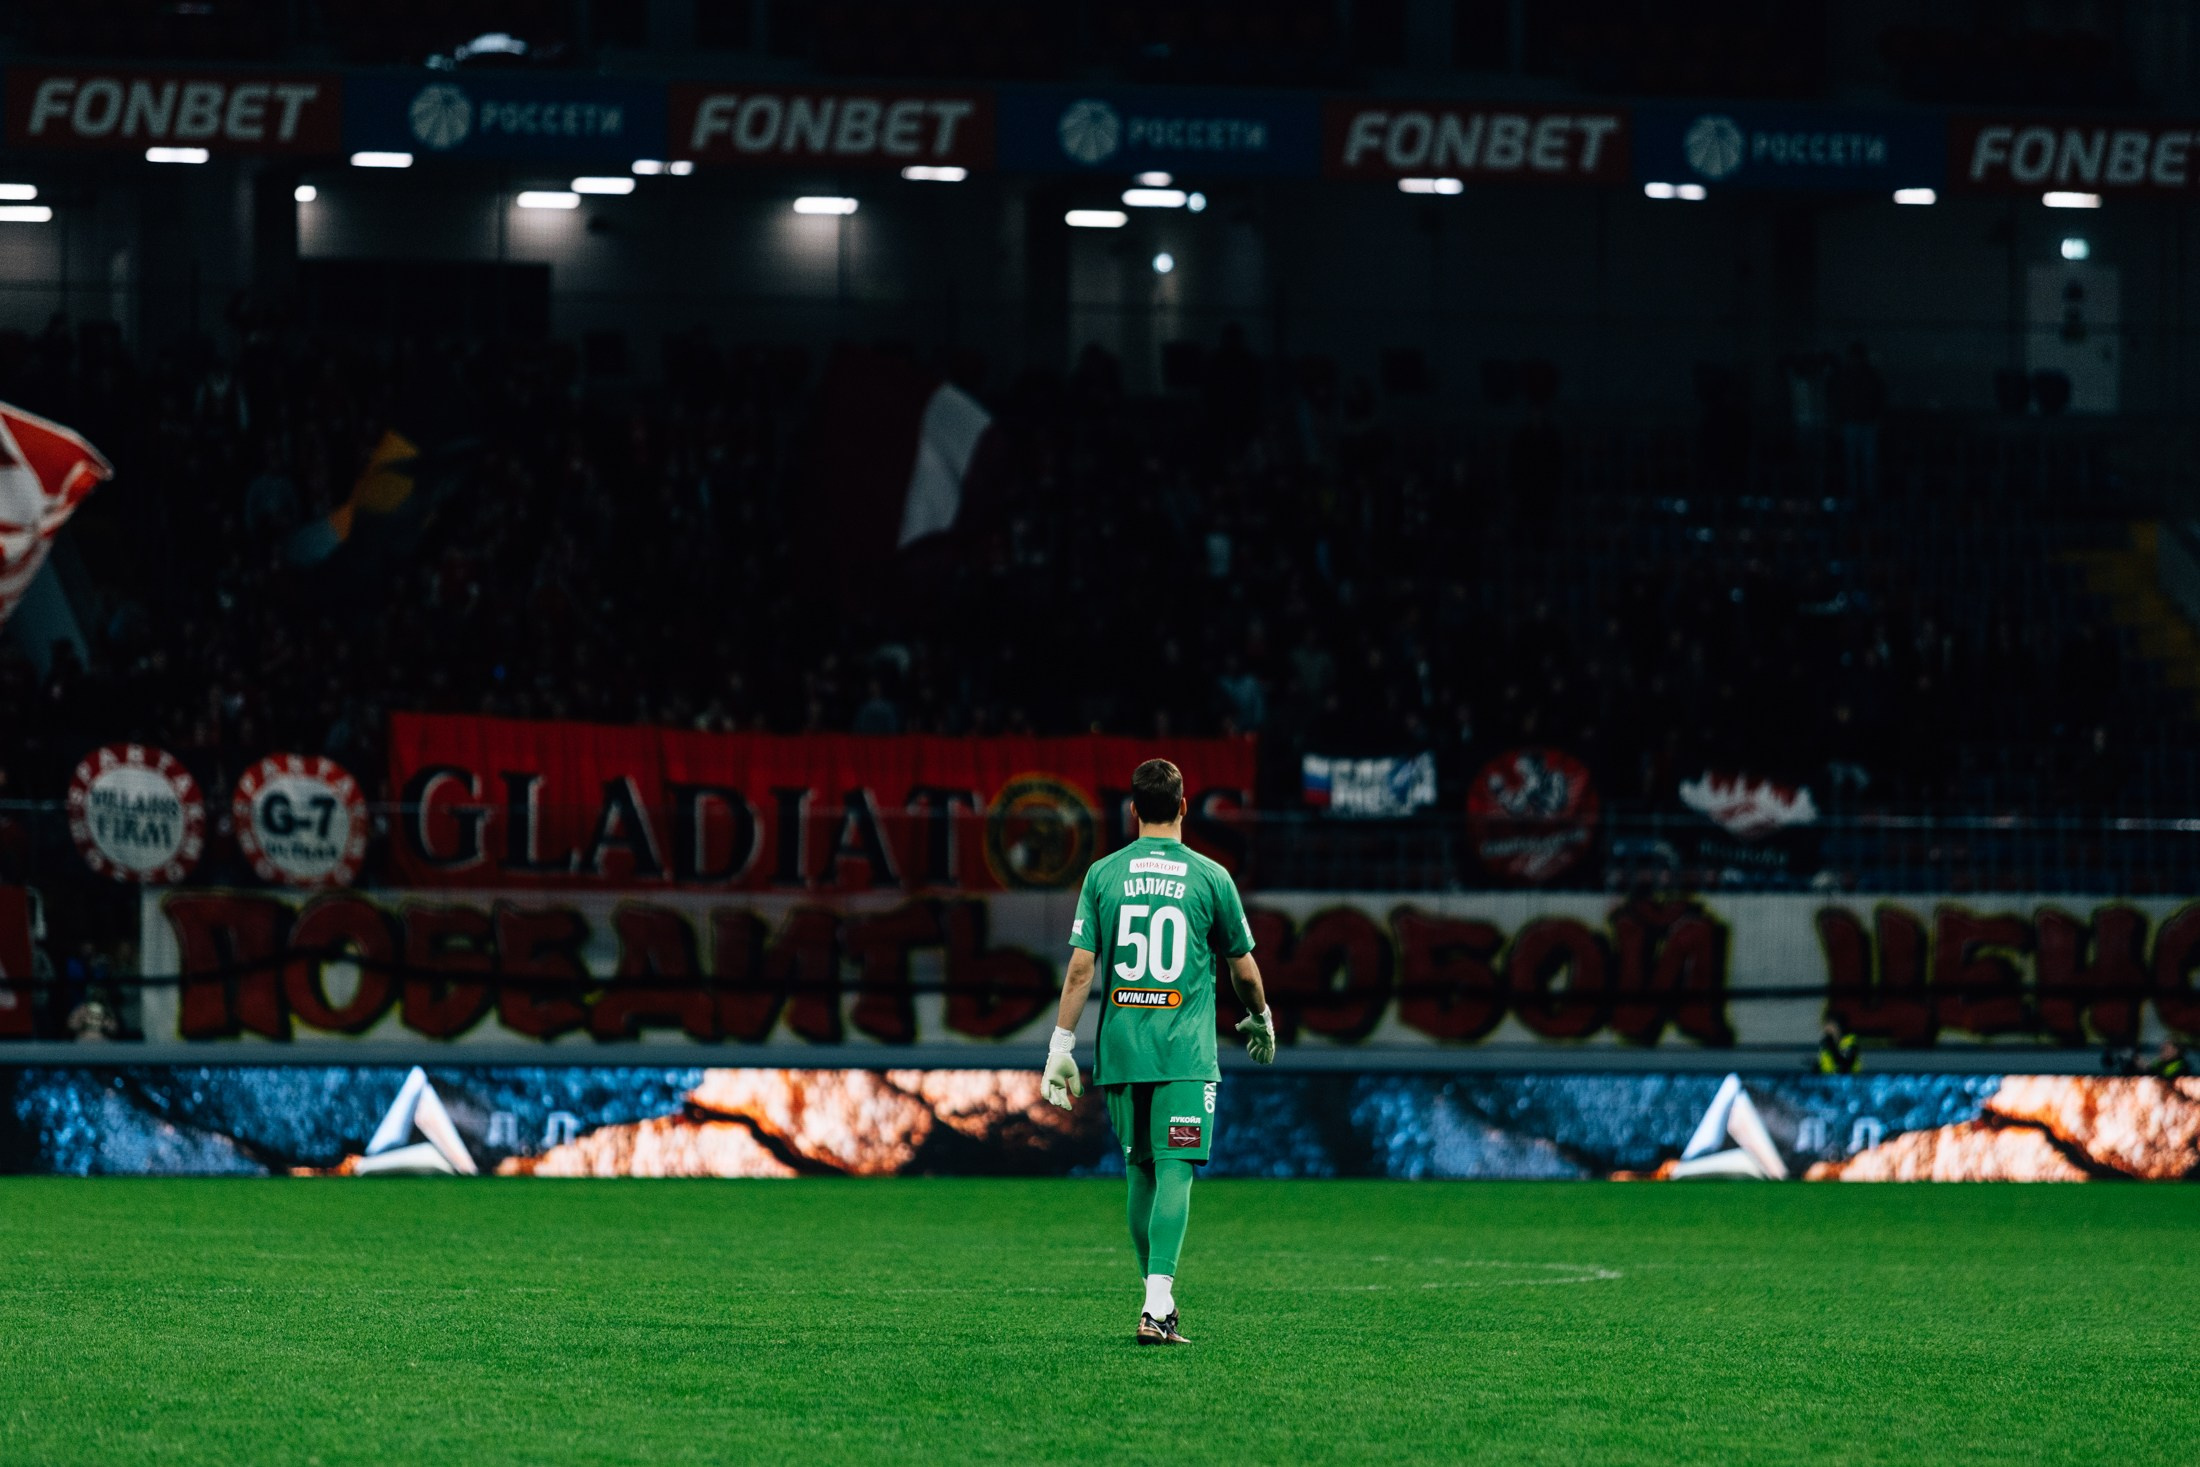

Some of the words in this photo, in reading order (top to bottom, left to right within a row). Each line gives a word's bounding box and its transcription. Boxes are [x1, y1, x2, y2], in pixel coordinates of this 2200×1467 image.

[28, 77, 318, 142] FONBET
[479, 102, 623, 136] РОССЕТИ
[689, 94, 975, 158] FONBET
[1126, 116, 1269, 150] РОССЕТИ
[1341, 110, 1621, 173] FONBET
[1750, 131, 1888, 167] РОССЕТИ
[1968, 124, 2200, 188] FONBE
[263, 793, 336, 839] G-7
[1123, 877, 1186, 899] ЦАЛИЕВ
[1114, 904, 1187, 983] 50
[163, 892, 1057, 1042] ПОБЕДИТЬ
[1217, 893, 1733, 1044] ЮБОЙ
[1117, 991, 1167, 1005] WINLINE
[1169, 1115, 1201, 1124] ЛУКОЙЛ
